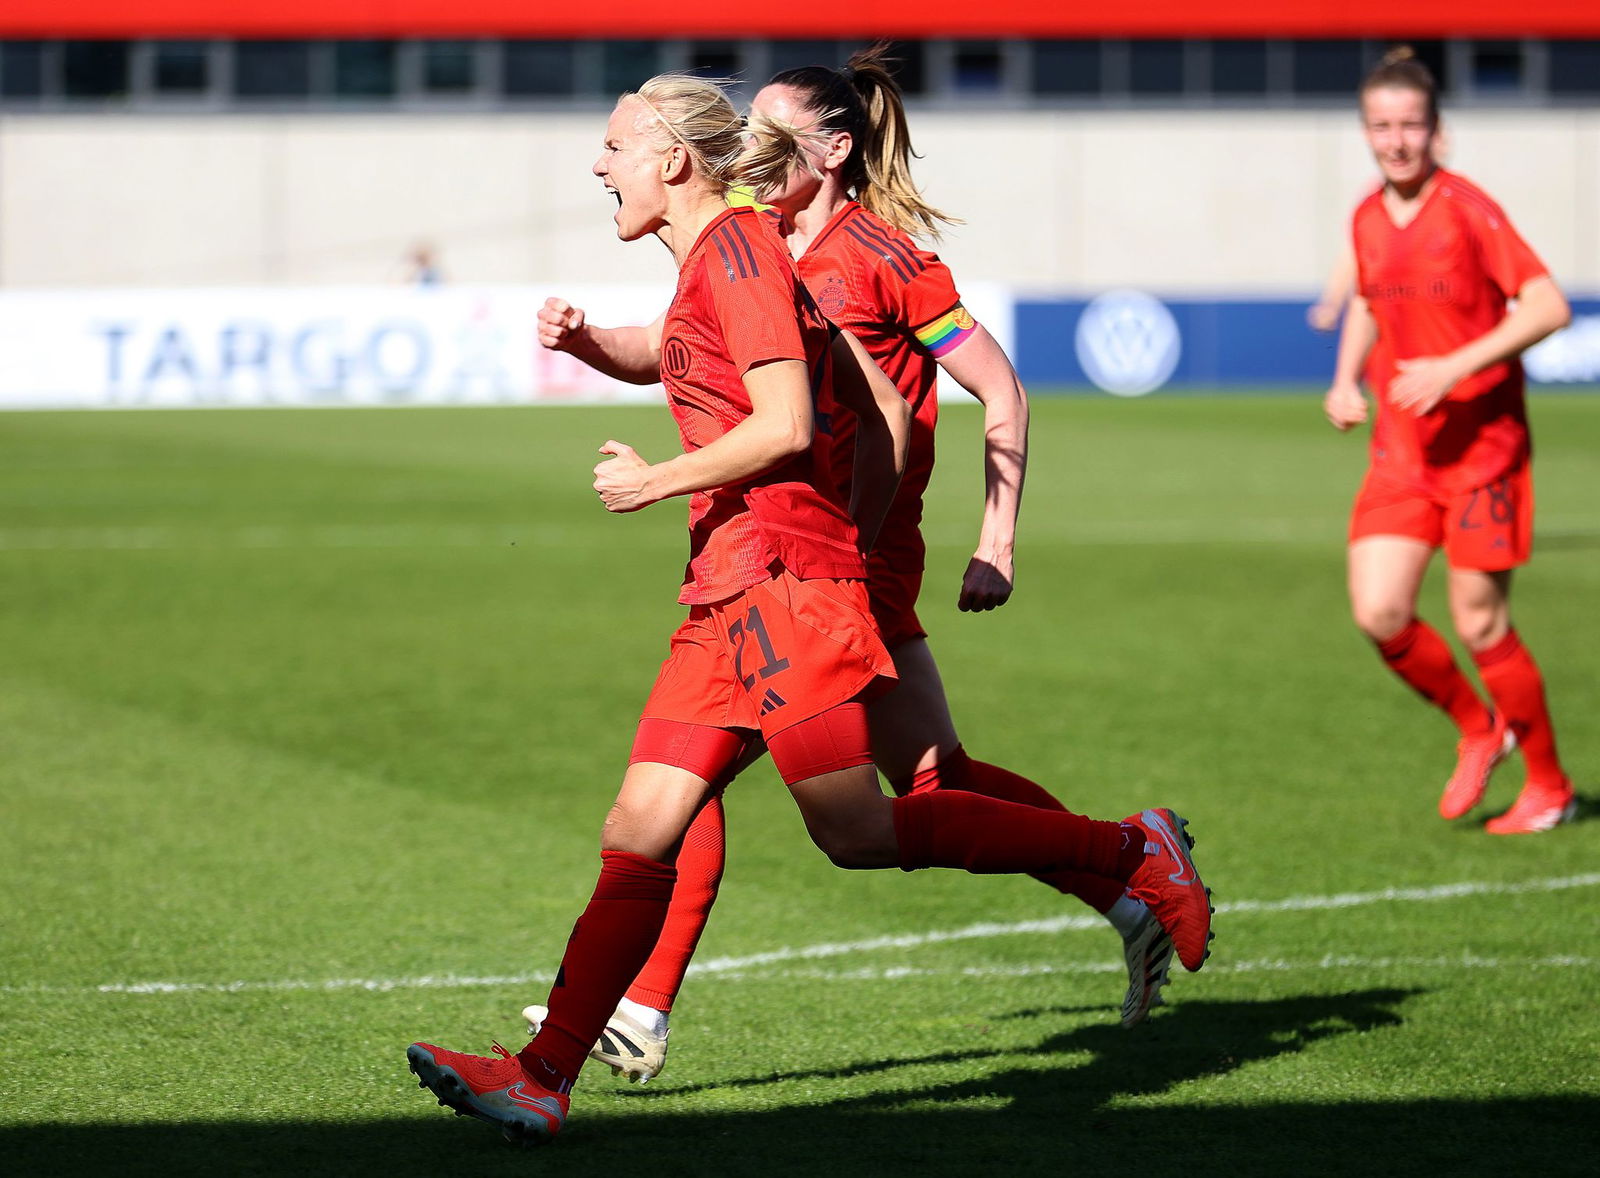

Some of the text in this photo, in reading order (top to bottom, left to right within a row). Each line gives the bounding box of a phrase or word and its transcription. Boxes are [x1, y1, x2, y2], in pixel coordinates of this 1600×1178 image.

[90, 315, 436, 397] TARGO
[1459, 480, 1514, 530] 28
[728, 604, 791, 693] 21
